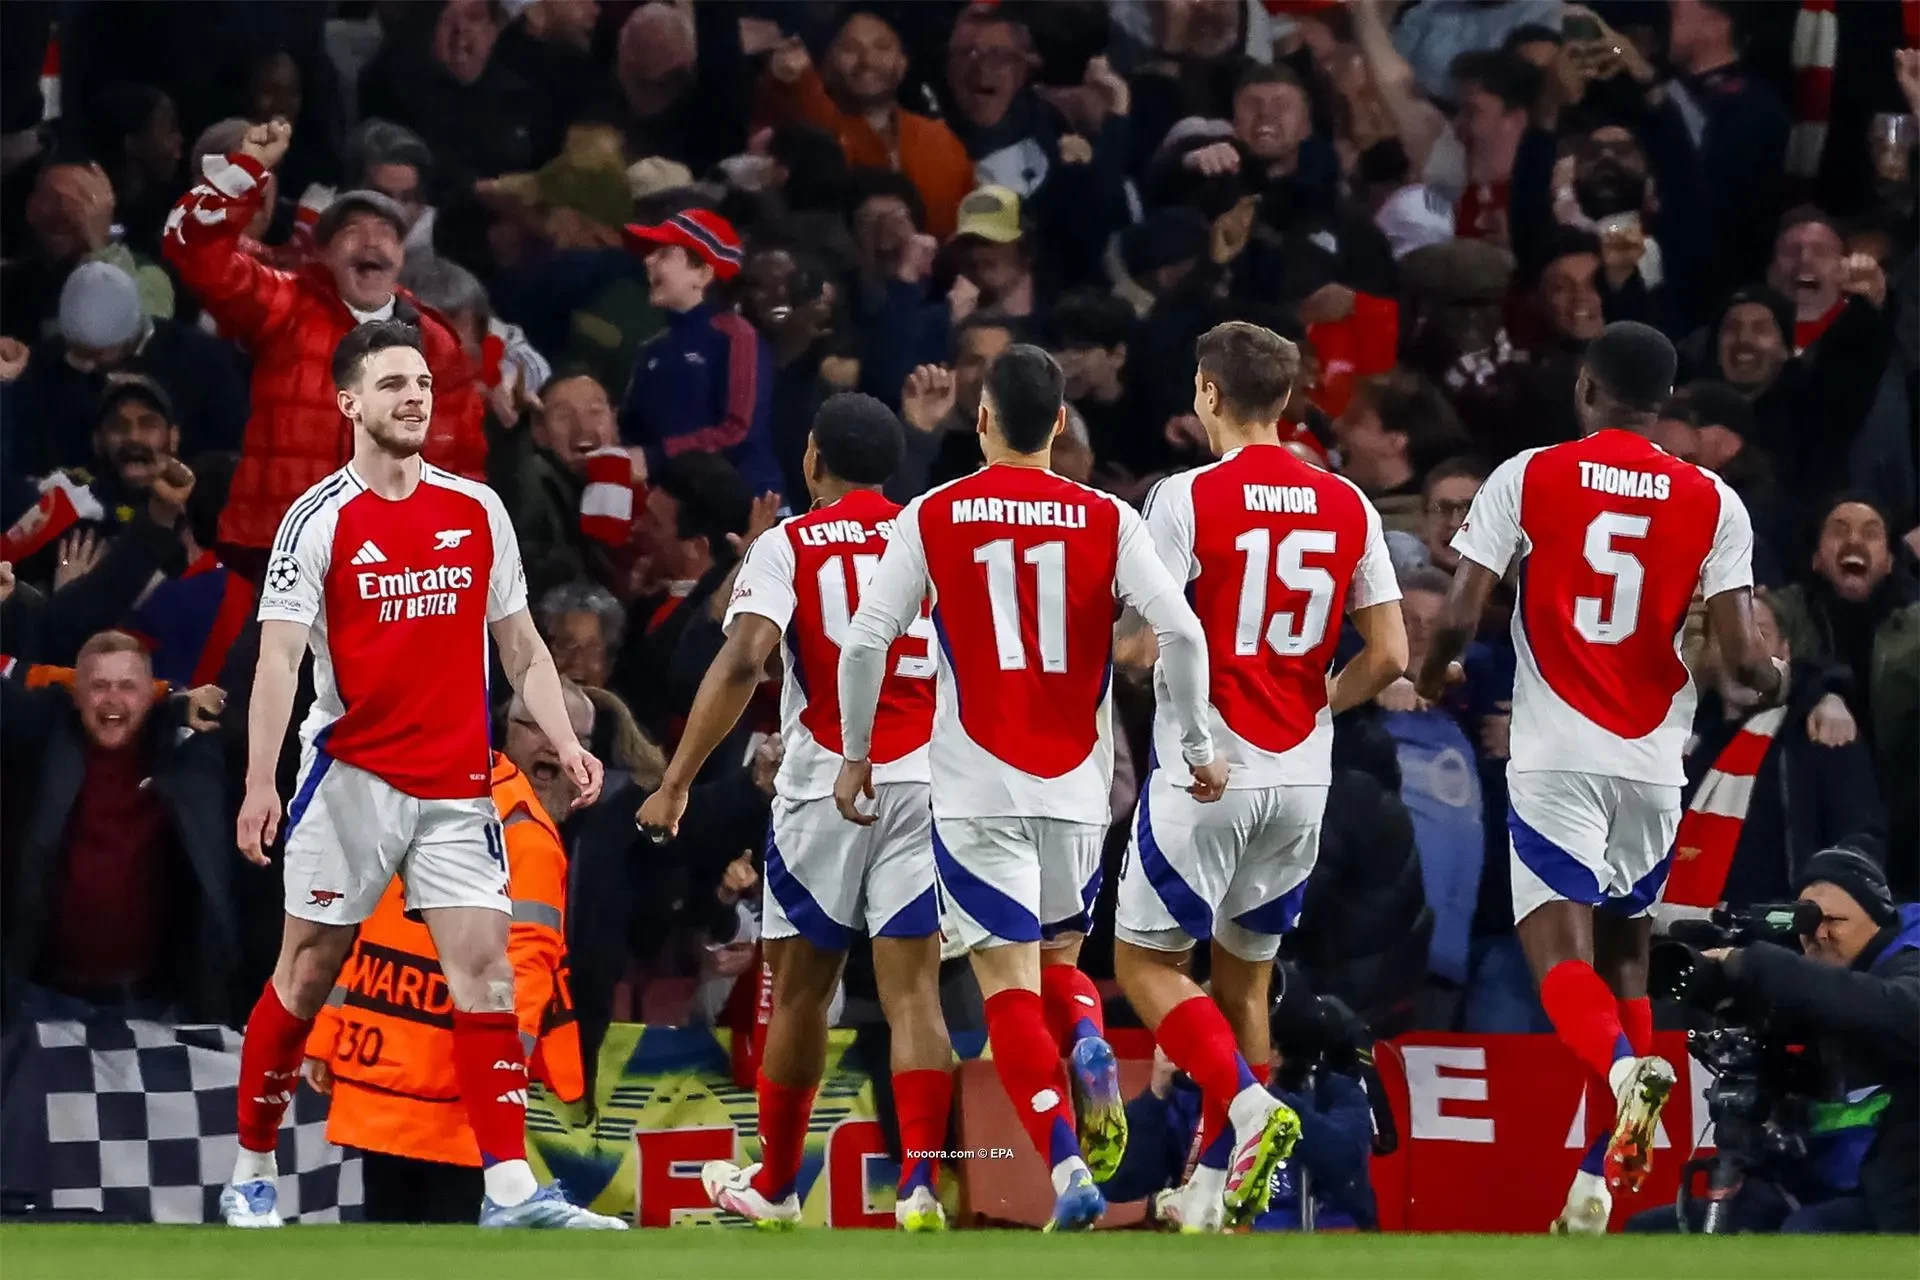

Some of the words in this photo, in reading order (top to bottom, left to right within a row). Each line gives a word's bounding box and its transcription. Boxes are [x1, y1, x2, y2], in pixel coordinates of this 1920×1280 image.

[1579, 461, 1671, 500] THOMAS
[952, 497, 1086, 528] MARTINELLI
[1243, 484, 1318, 514] KIWIOR
[798, 519, 897, 546] LEWIS-S
[357, 564, 473, 600] Emirates
[1235, 528, 1337, 656] 15
[1574, 510, 1651, 645] 5
[378, 600, 403, 623] FLY
[406, 593, 457, 619] BETTER
[973, 538, 1067, 674] 11
